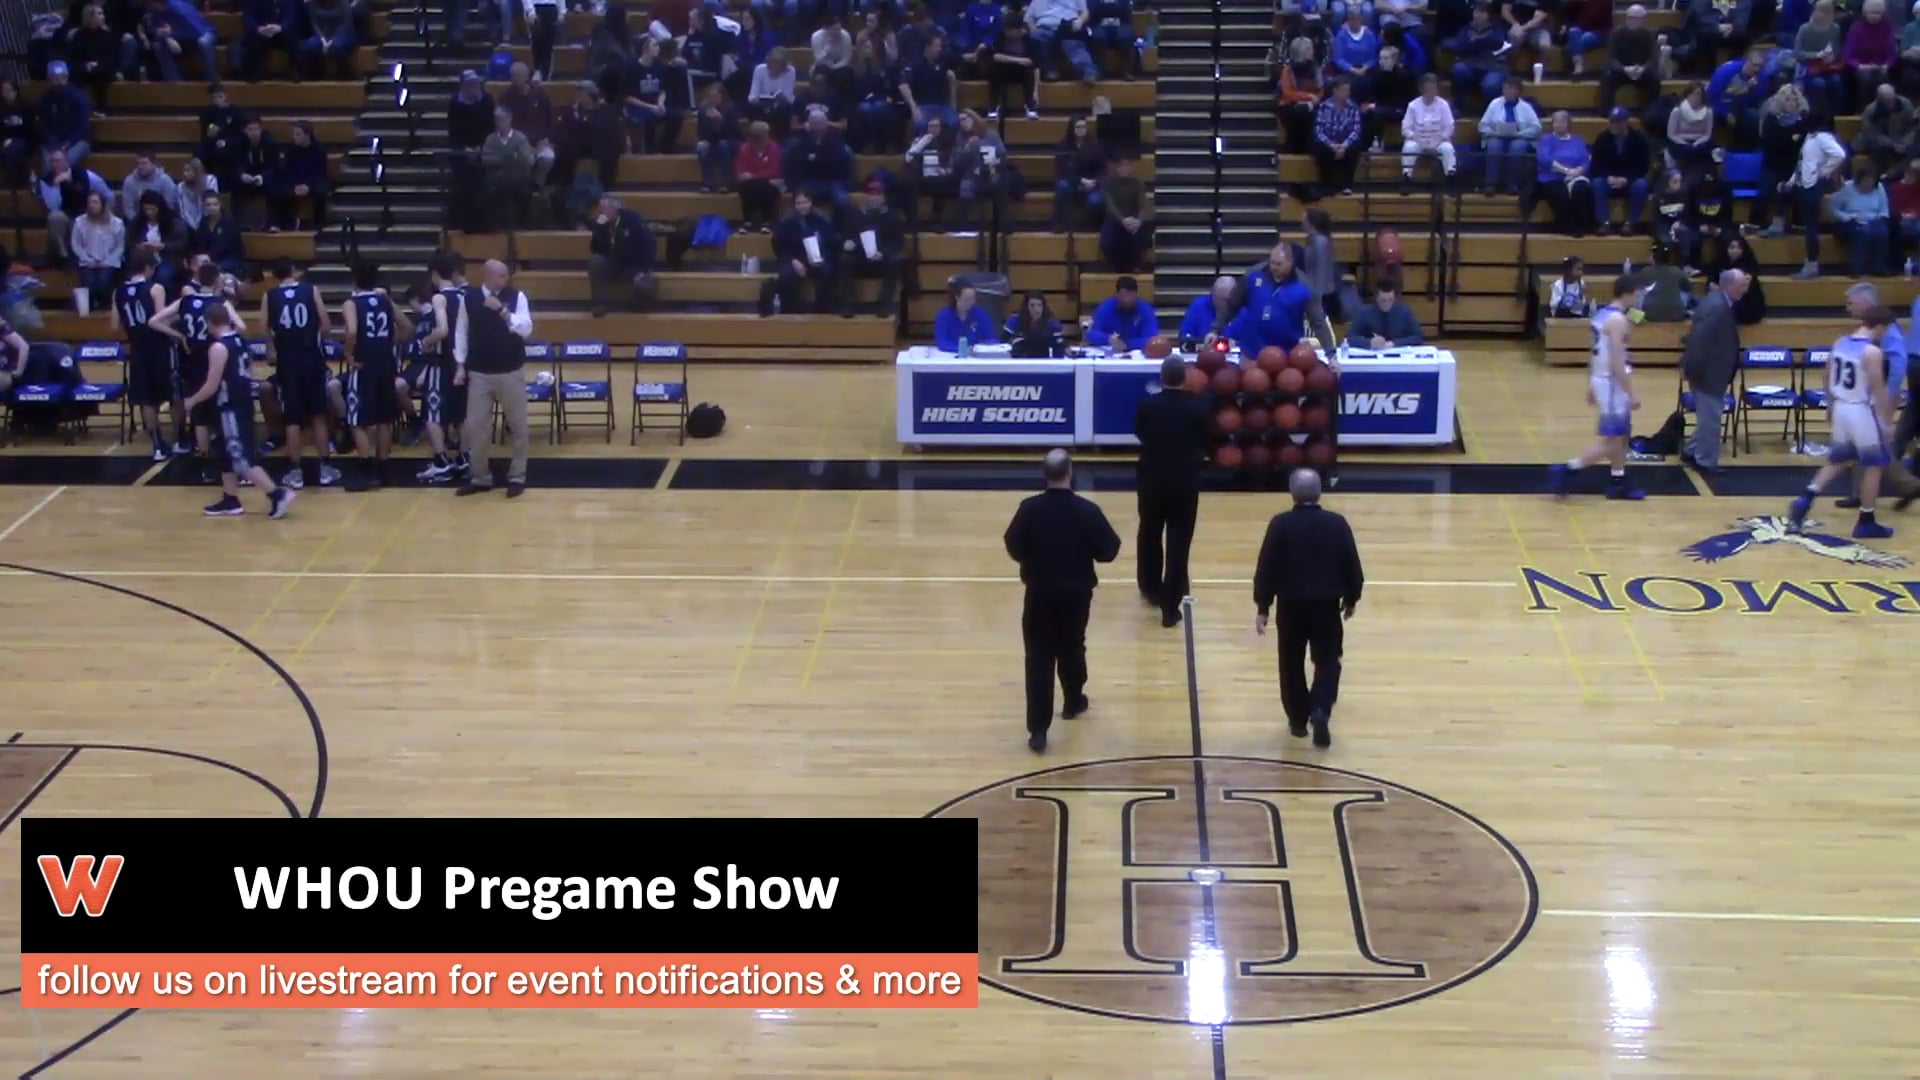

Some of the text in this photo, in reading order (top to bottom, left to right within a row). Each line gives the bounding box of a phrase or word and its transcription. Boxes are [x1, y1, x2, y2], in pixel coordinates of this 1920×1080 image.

[123, 300, 147, 328] 10
[183, 313, 209, 341] 32
[278, 302, 309, 330] 40
[365, 311, 389, 338] 52
[1833, 356, 1857, 390] 13
[946, 385, 1043, 401] HERMON
[1338, 392, 1421, 415] WKS
[921, 407, 1067, 423] HIGH SCHOOL
